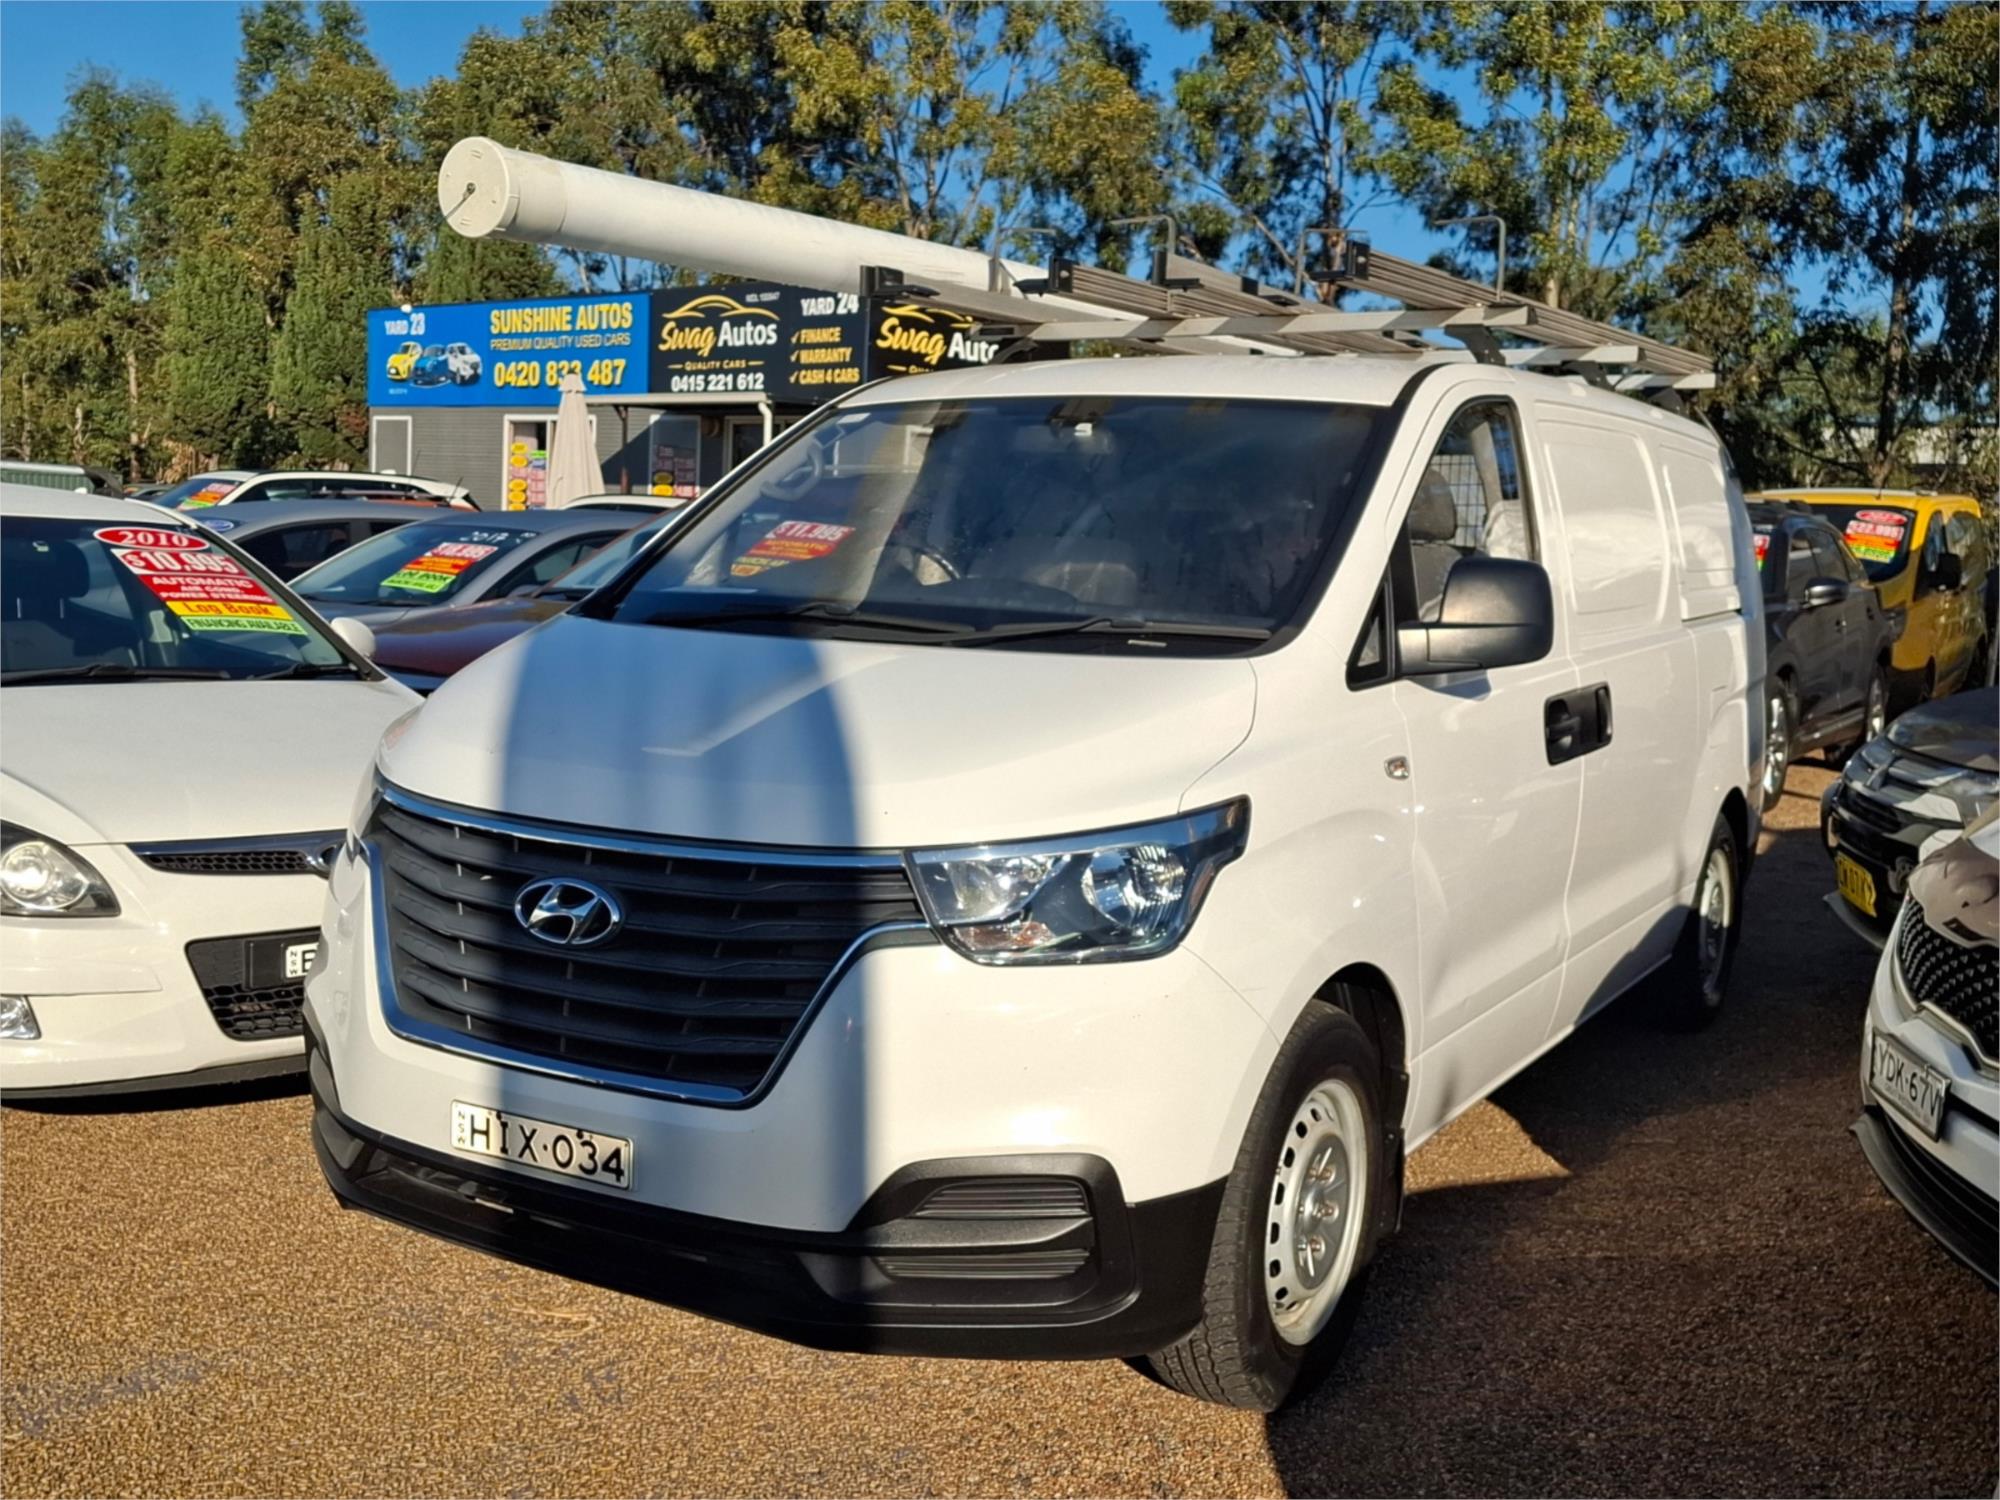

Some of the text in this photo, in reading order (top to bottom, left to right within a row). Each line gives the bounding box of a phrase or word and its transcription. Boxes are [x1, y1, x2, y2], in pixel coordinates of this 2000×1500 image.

[801, 292, 859, 316] YARD 24
[490, 303, 632, 334] SUNSHINE AUTOS
[490, 333, 631, 350] PREMIUM QUALITY USED CARS
[658, 320, 778, 357] Swag Autos
[800, 327, 841, 344] FINANCE
[876, 317, 999, 365] Swag Aut
[800, 347, 852, 364] WARRANTY
[494, 361, 540, 387] 0420
[587, 358, 626, 385] 487
[684, 359, 747, 371] QUALITY CARS
[671, 372, 764, 392] 0415 221 612
[799, 367, 860, 384] CASH 4 CARS
[118, 531, 189, 547] 2010
[126, 551, 239, 573] $10,995
[152, 576, 254, 588] AUTOMATIC
[184, 603, 273, 616] Log Book
